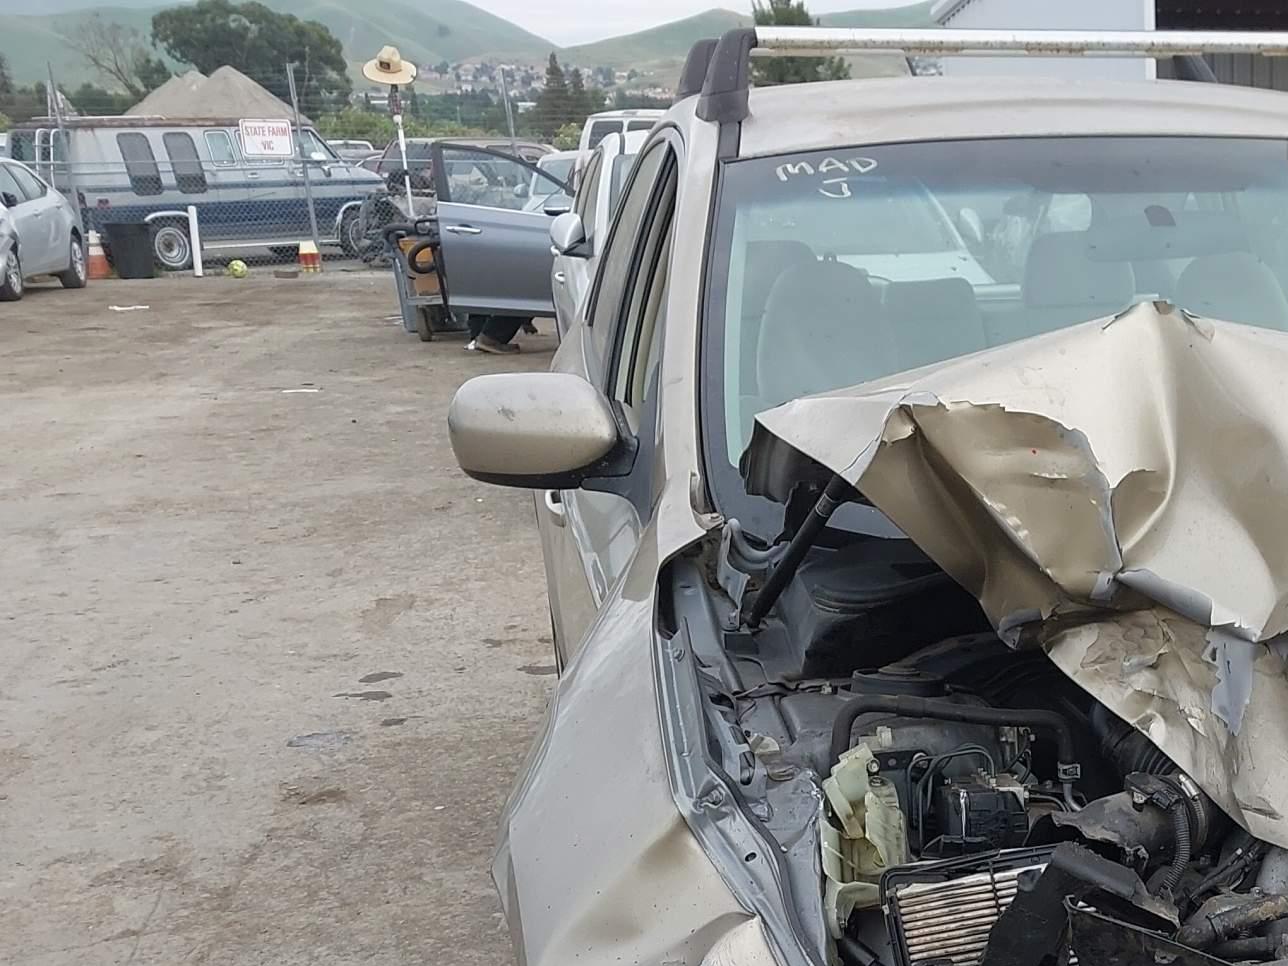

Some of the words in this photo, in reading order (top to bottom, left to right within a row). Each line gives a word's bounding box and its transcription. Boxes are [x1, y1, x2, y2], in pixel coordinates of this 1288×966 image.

[245, 126, 266, 137] STATE
[268, 126, 289, 137] FARM
[776, 157, 877, 182] MAD
